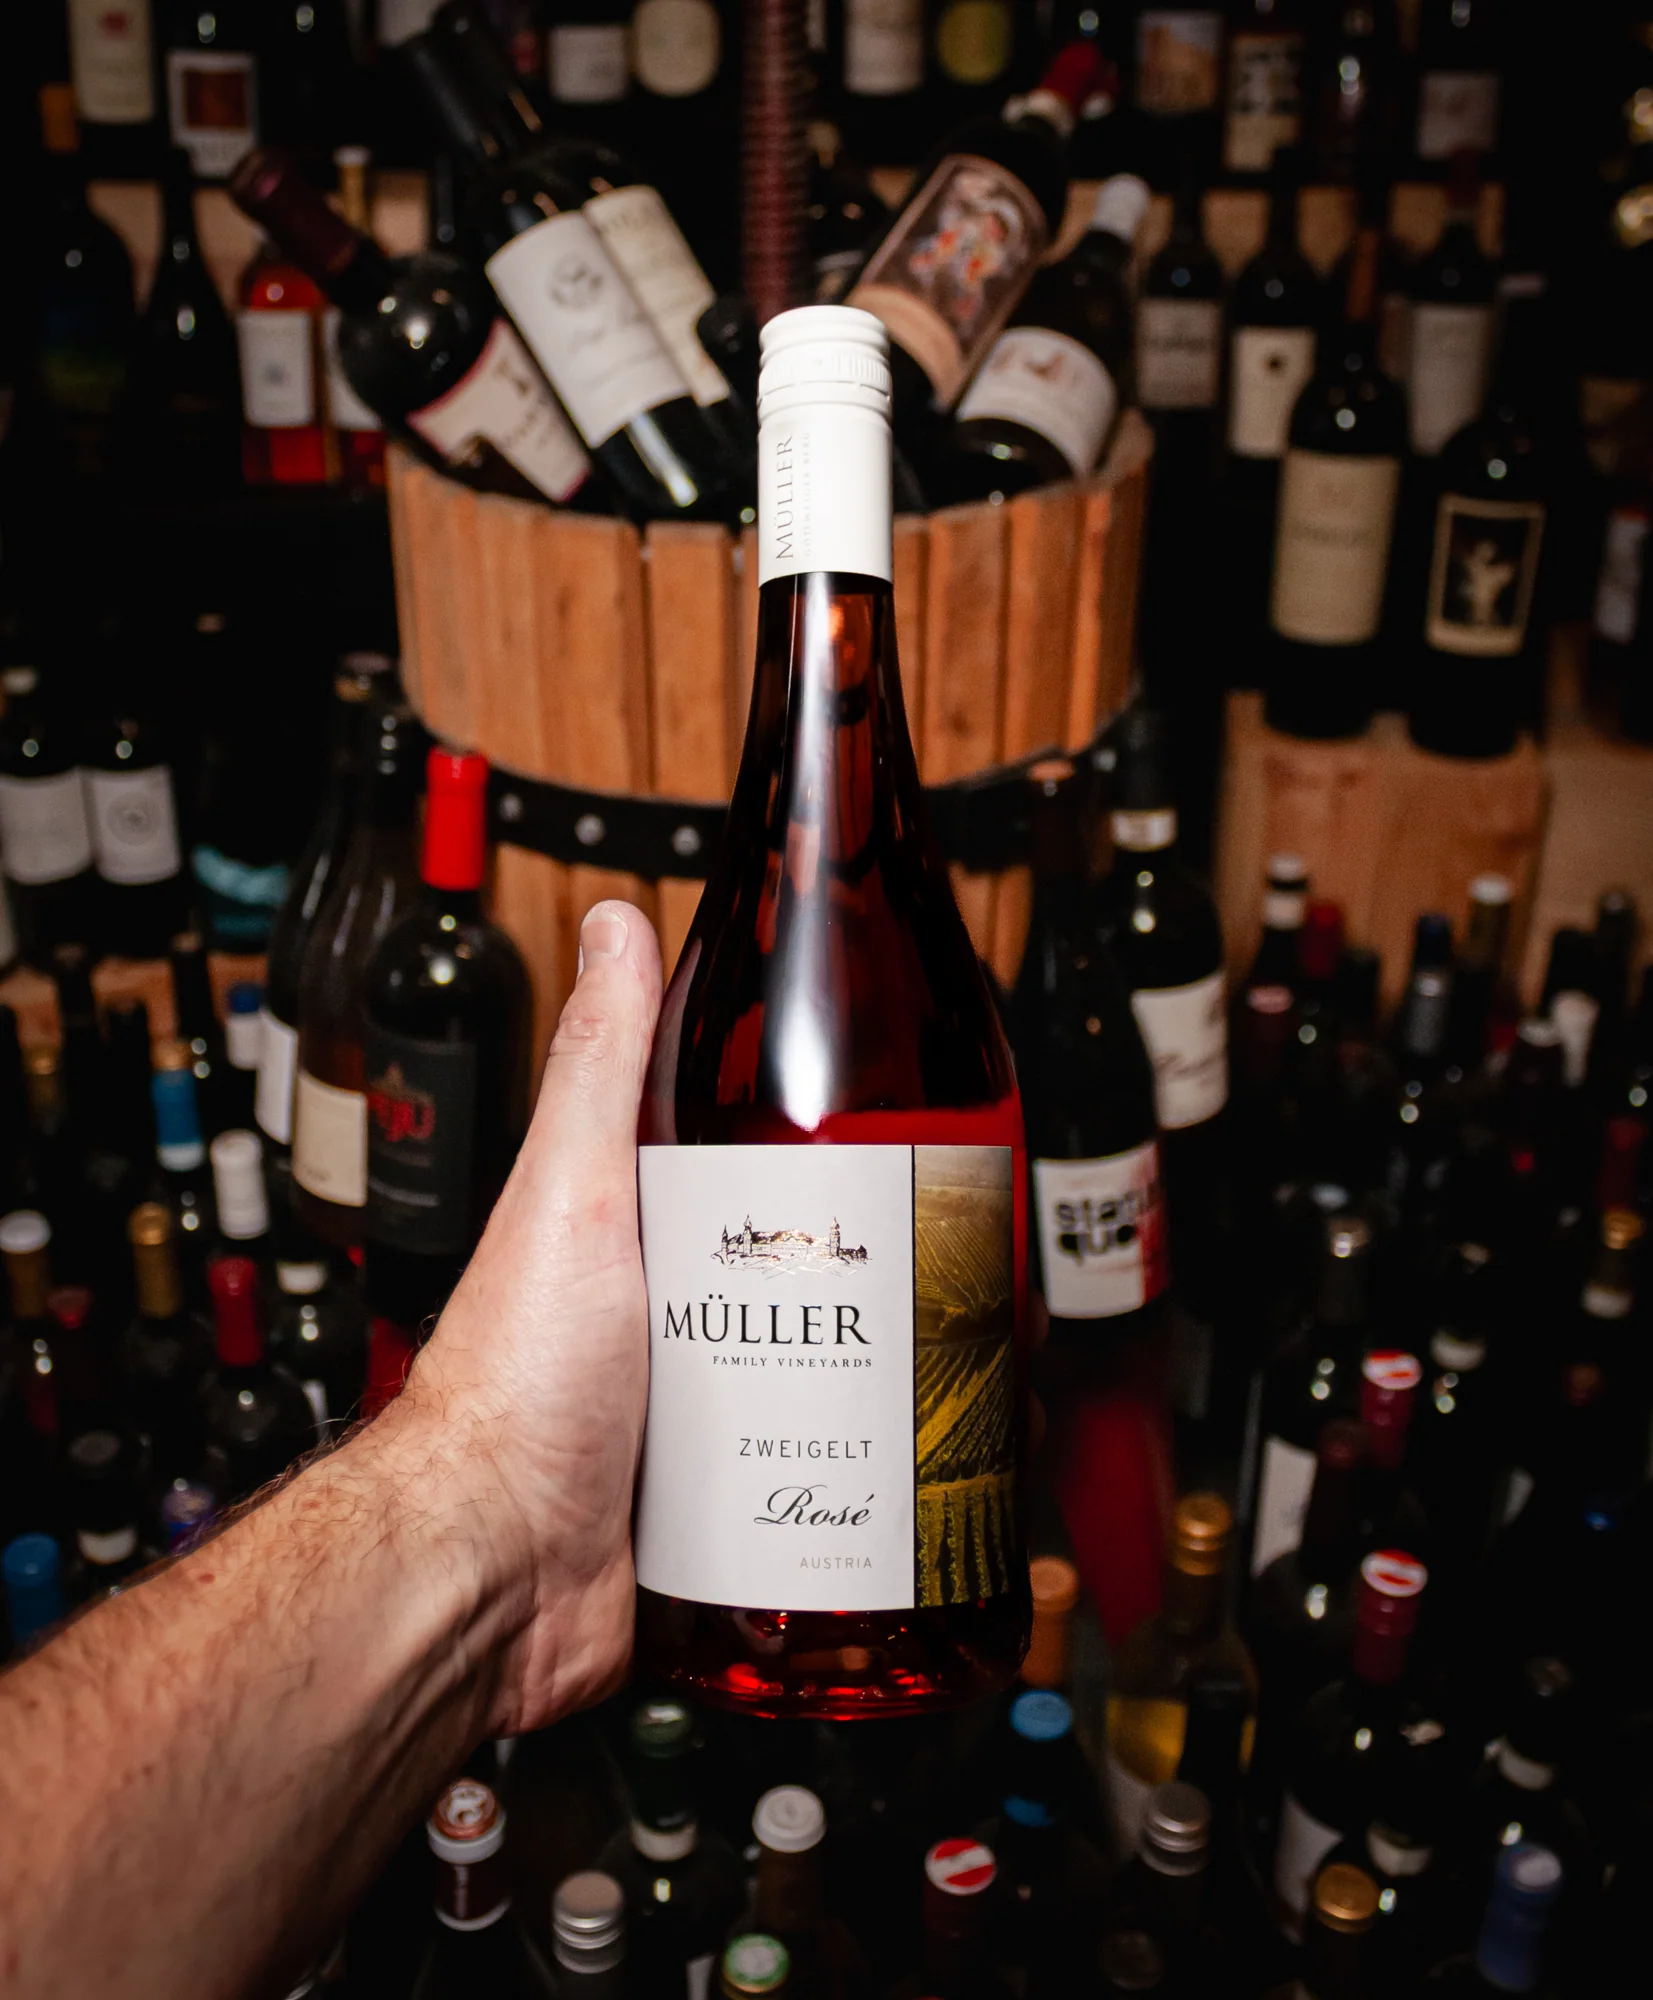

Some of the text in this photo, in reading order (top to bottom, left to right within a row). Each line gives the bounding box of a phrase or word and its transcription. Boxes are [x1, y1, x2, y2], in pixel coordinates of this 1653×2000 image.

[774, 435, 794, 559] MÜLLER
[663, 1293, 873, 1345] MÜLLER
[713, 1356, 873, 1368] FAMILY VINEYARDS
[739, 1438, 873, 1459] ZWEIGELT
[753, 1484, 875, 1527] Rosé
[800, 1556, 873, 1569] AUSTRIA
